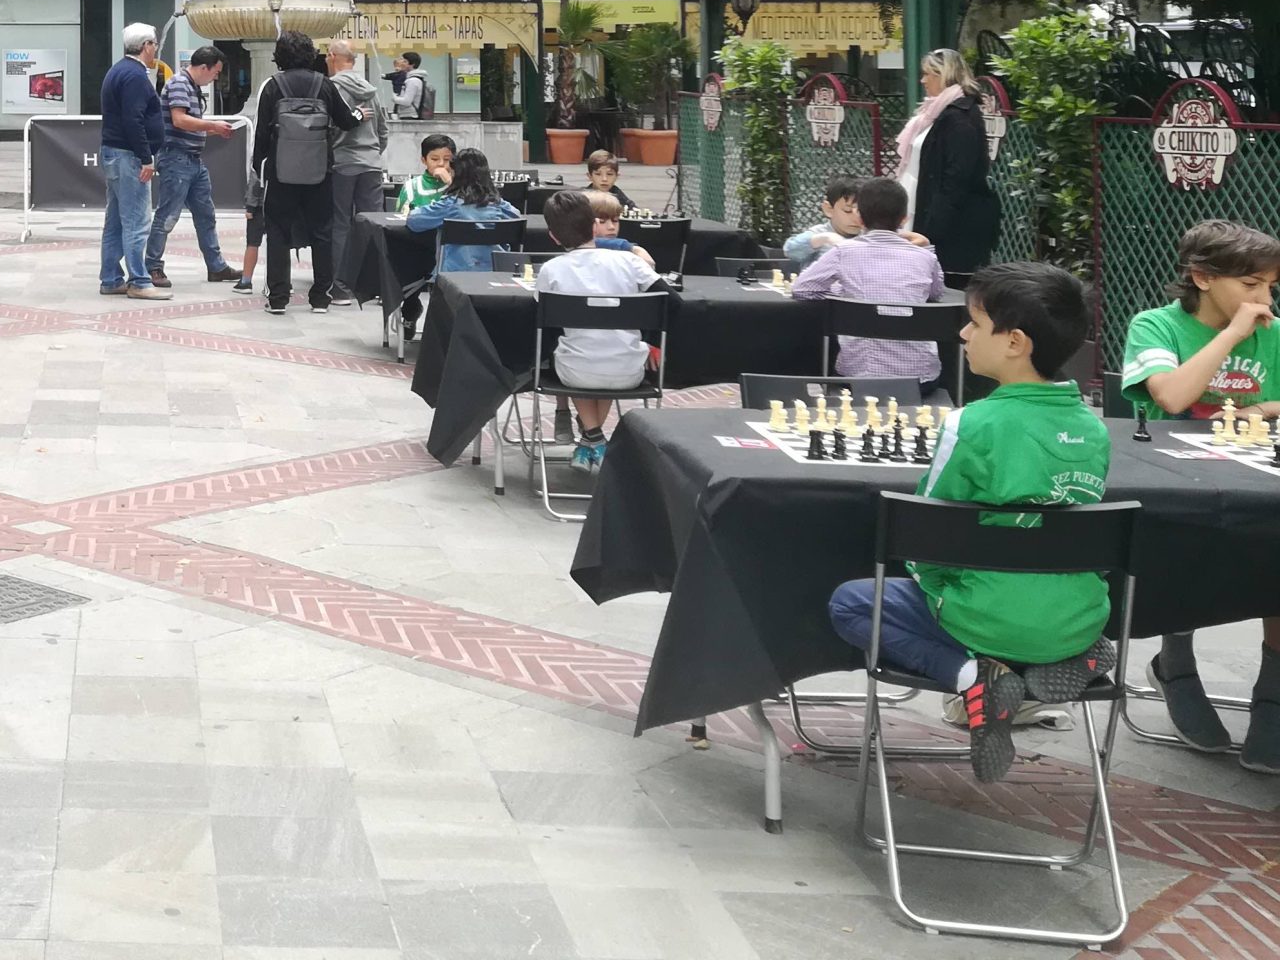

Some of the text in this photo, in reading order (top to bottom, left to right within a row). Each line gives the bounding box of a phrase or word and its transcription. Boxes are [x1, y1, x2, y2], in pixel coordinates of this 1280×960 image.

[329, 15, 483, 39] FETERIA PIZZERIA TAPAS
[6, 52, 29, 60] now
[1169, 131, 1219, 153] CHIKITO
